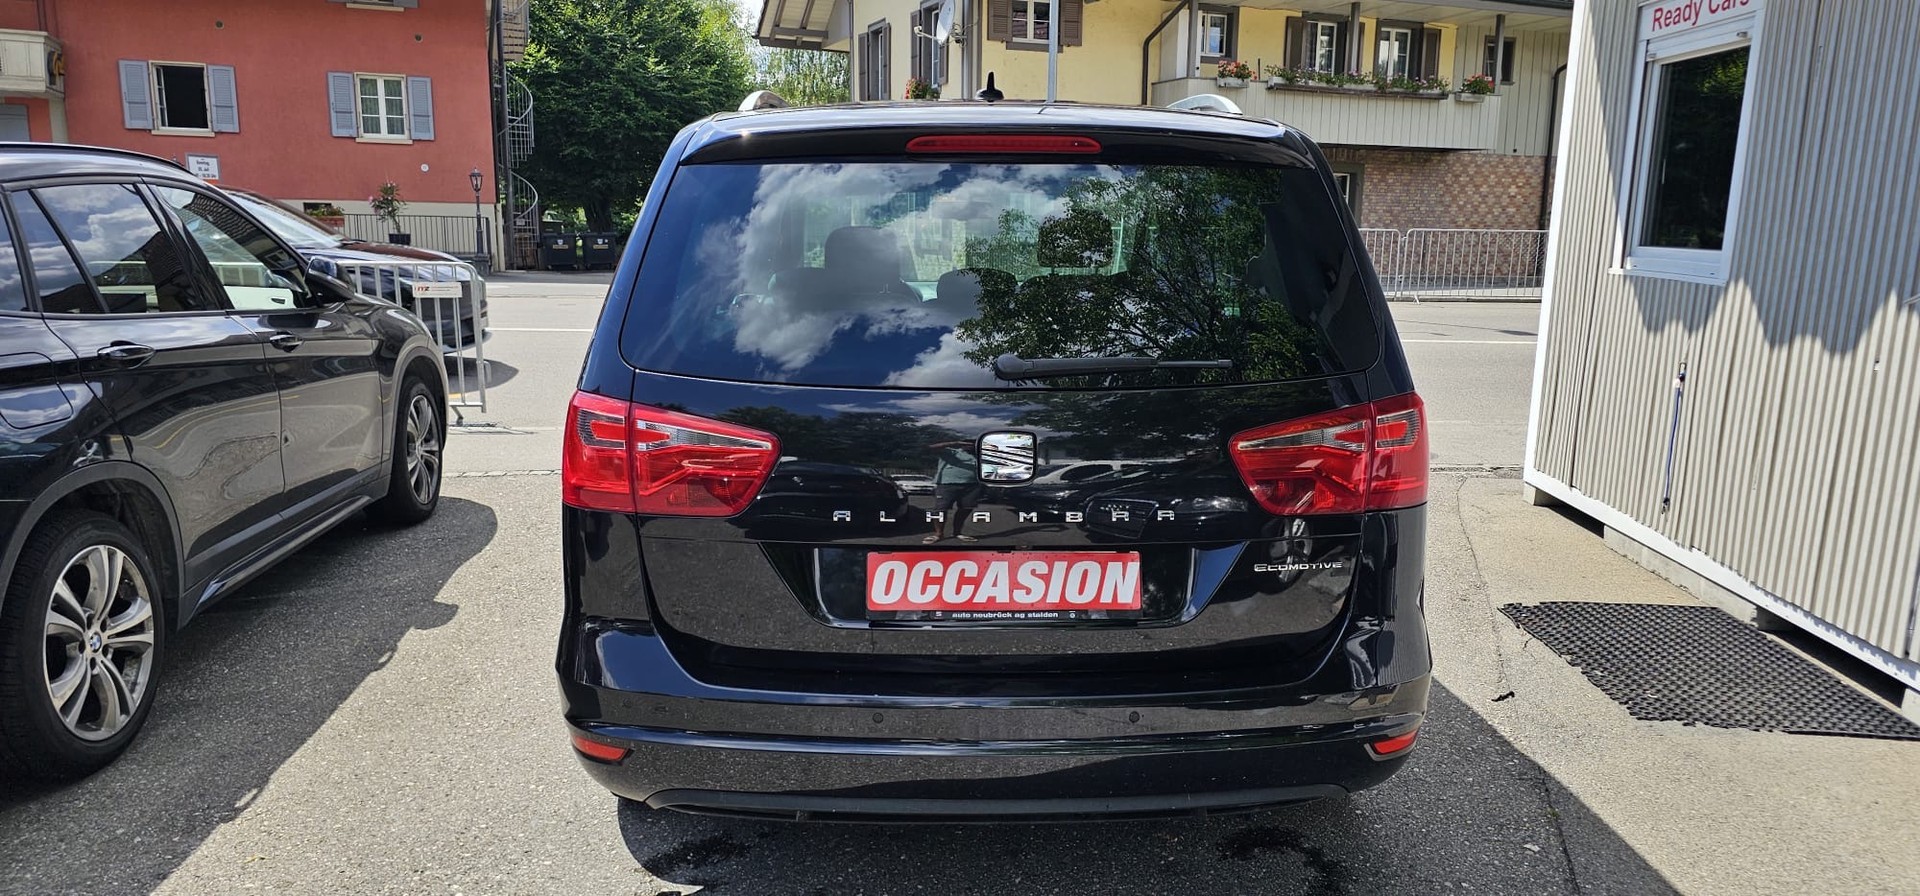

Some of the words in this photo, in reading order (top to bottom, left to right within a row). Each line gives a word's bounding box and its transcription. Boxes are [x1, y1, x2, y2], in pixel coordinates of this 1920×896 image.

[1652, 0, 1703, 32] Ready
[832, 509, 1176, 523] ALHAMBRA
[870, 560, 1141, 605] OCCASION
